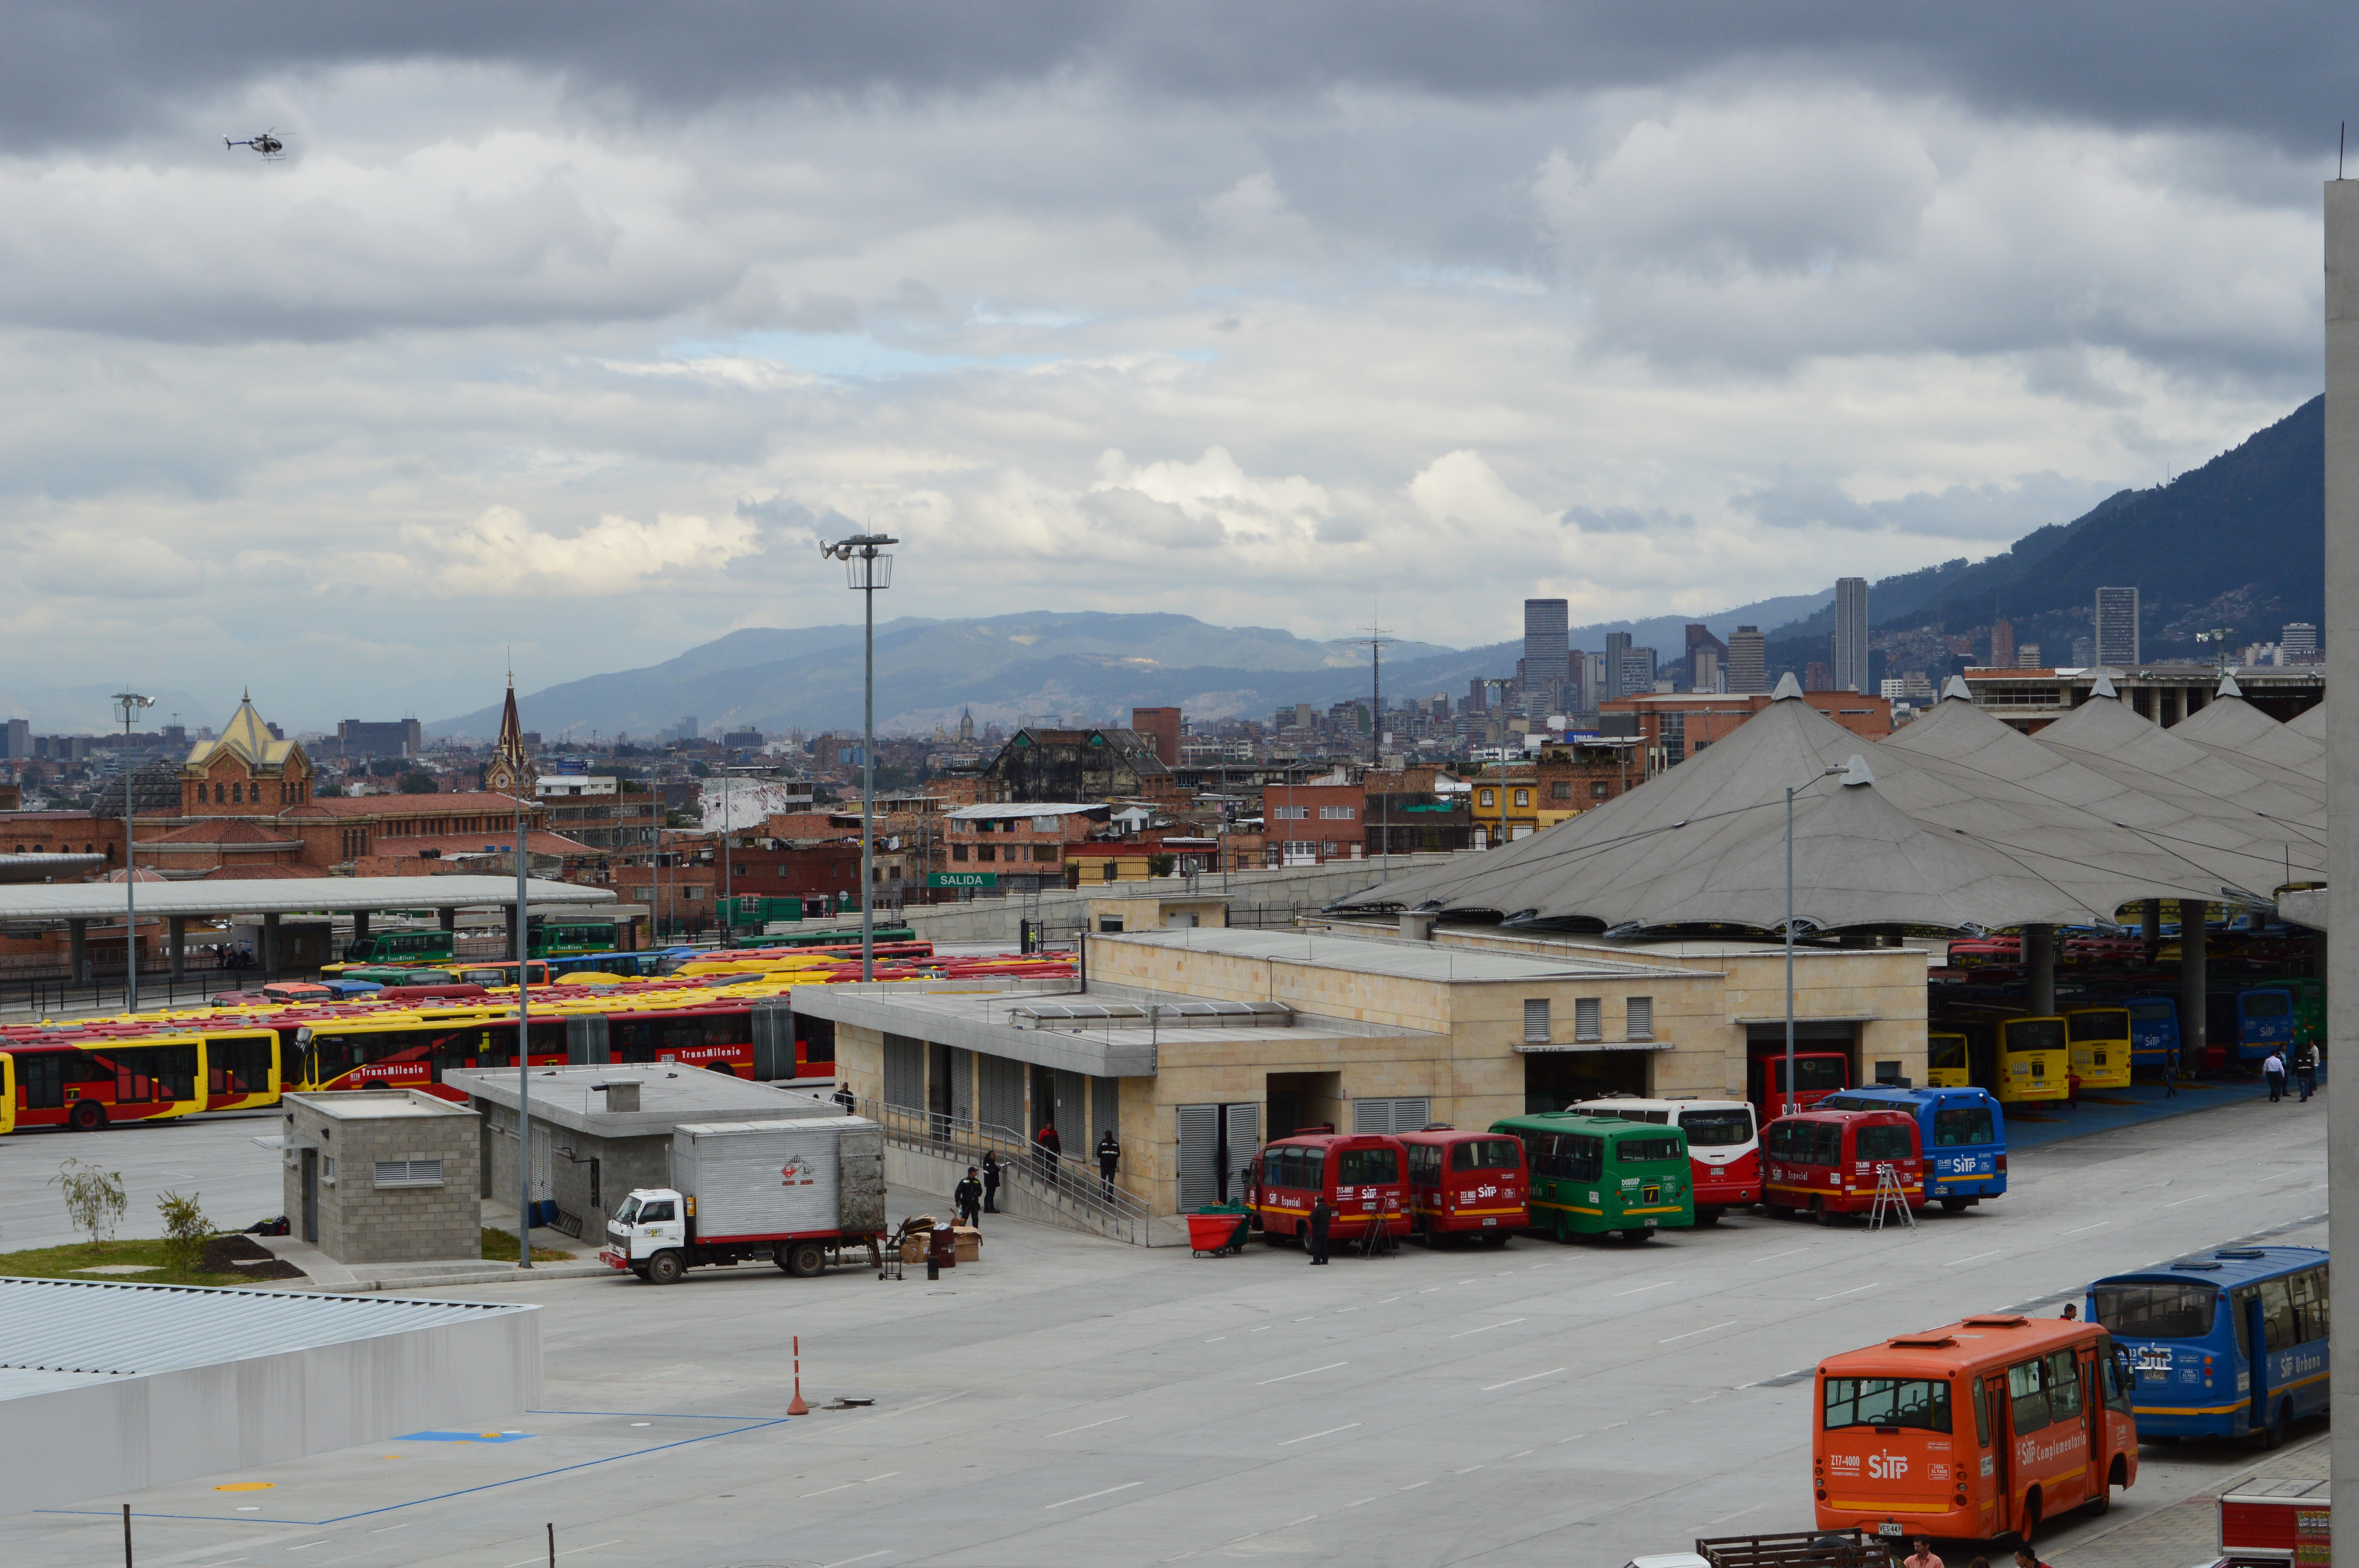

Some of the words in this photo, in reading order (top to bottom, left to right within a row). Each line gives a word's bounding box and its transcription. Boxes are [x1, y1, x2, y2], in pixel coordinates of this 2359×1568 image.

[941, 876, 983, 885] SALIDA
[682, 1047, 740, 1058] TransMilenio
[2076, 1051, 2091, 1060] D121
[362, 1065, 423, 1076] TransMilenio
[2013, 1062, 2029, 1071] N105
[1782, 1103, 1801, 1115] D21
[1788, 1171, 1807, 1181] Especial
[1282, 1196, 1300, 1208] Especial
[2296, 1354, 2320, 1373] Urbano
[2037, 1432, 2086, 1461] Complementario
[1831, 1455, 1860, 1466] Z17-4000
